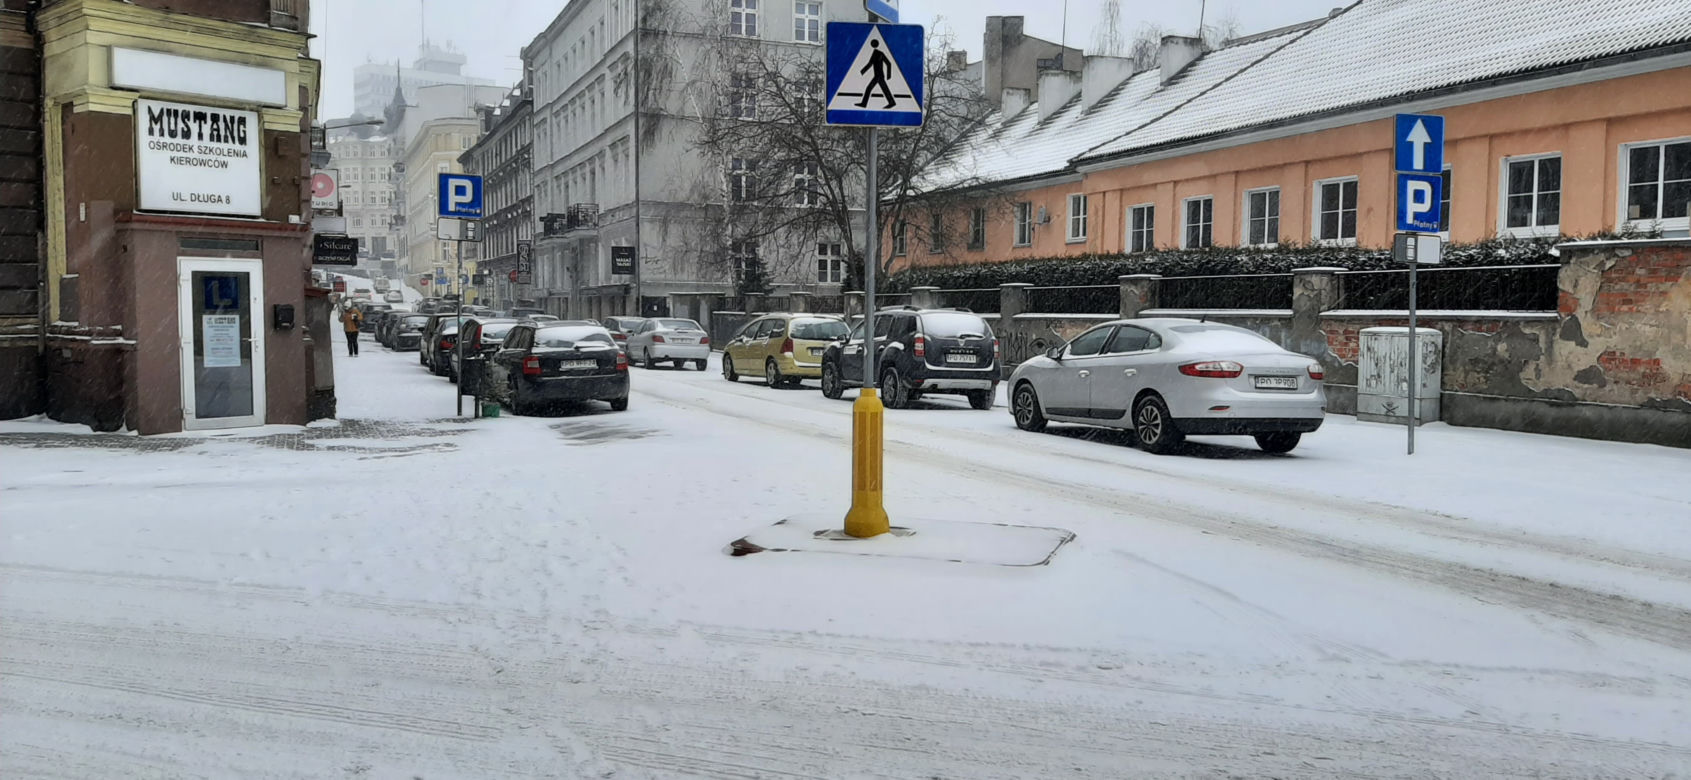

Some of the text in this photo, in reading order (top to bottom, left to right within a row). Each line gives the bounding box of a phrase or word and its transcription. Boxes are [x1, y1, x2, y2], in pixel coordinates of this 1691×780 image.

[148, 105, 247, 146] MUSTANG
[149, 140, 248, 158] OŚRODEK SZKOLENIA
[170, 156, 228, 169] KIEROWCÓW
[172, 192, 231, 204] UL. DŁUGA 8
[448, 178, 474, 212] P
[1407, 181, 1432, 224] P
